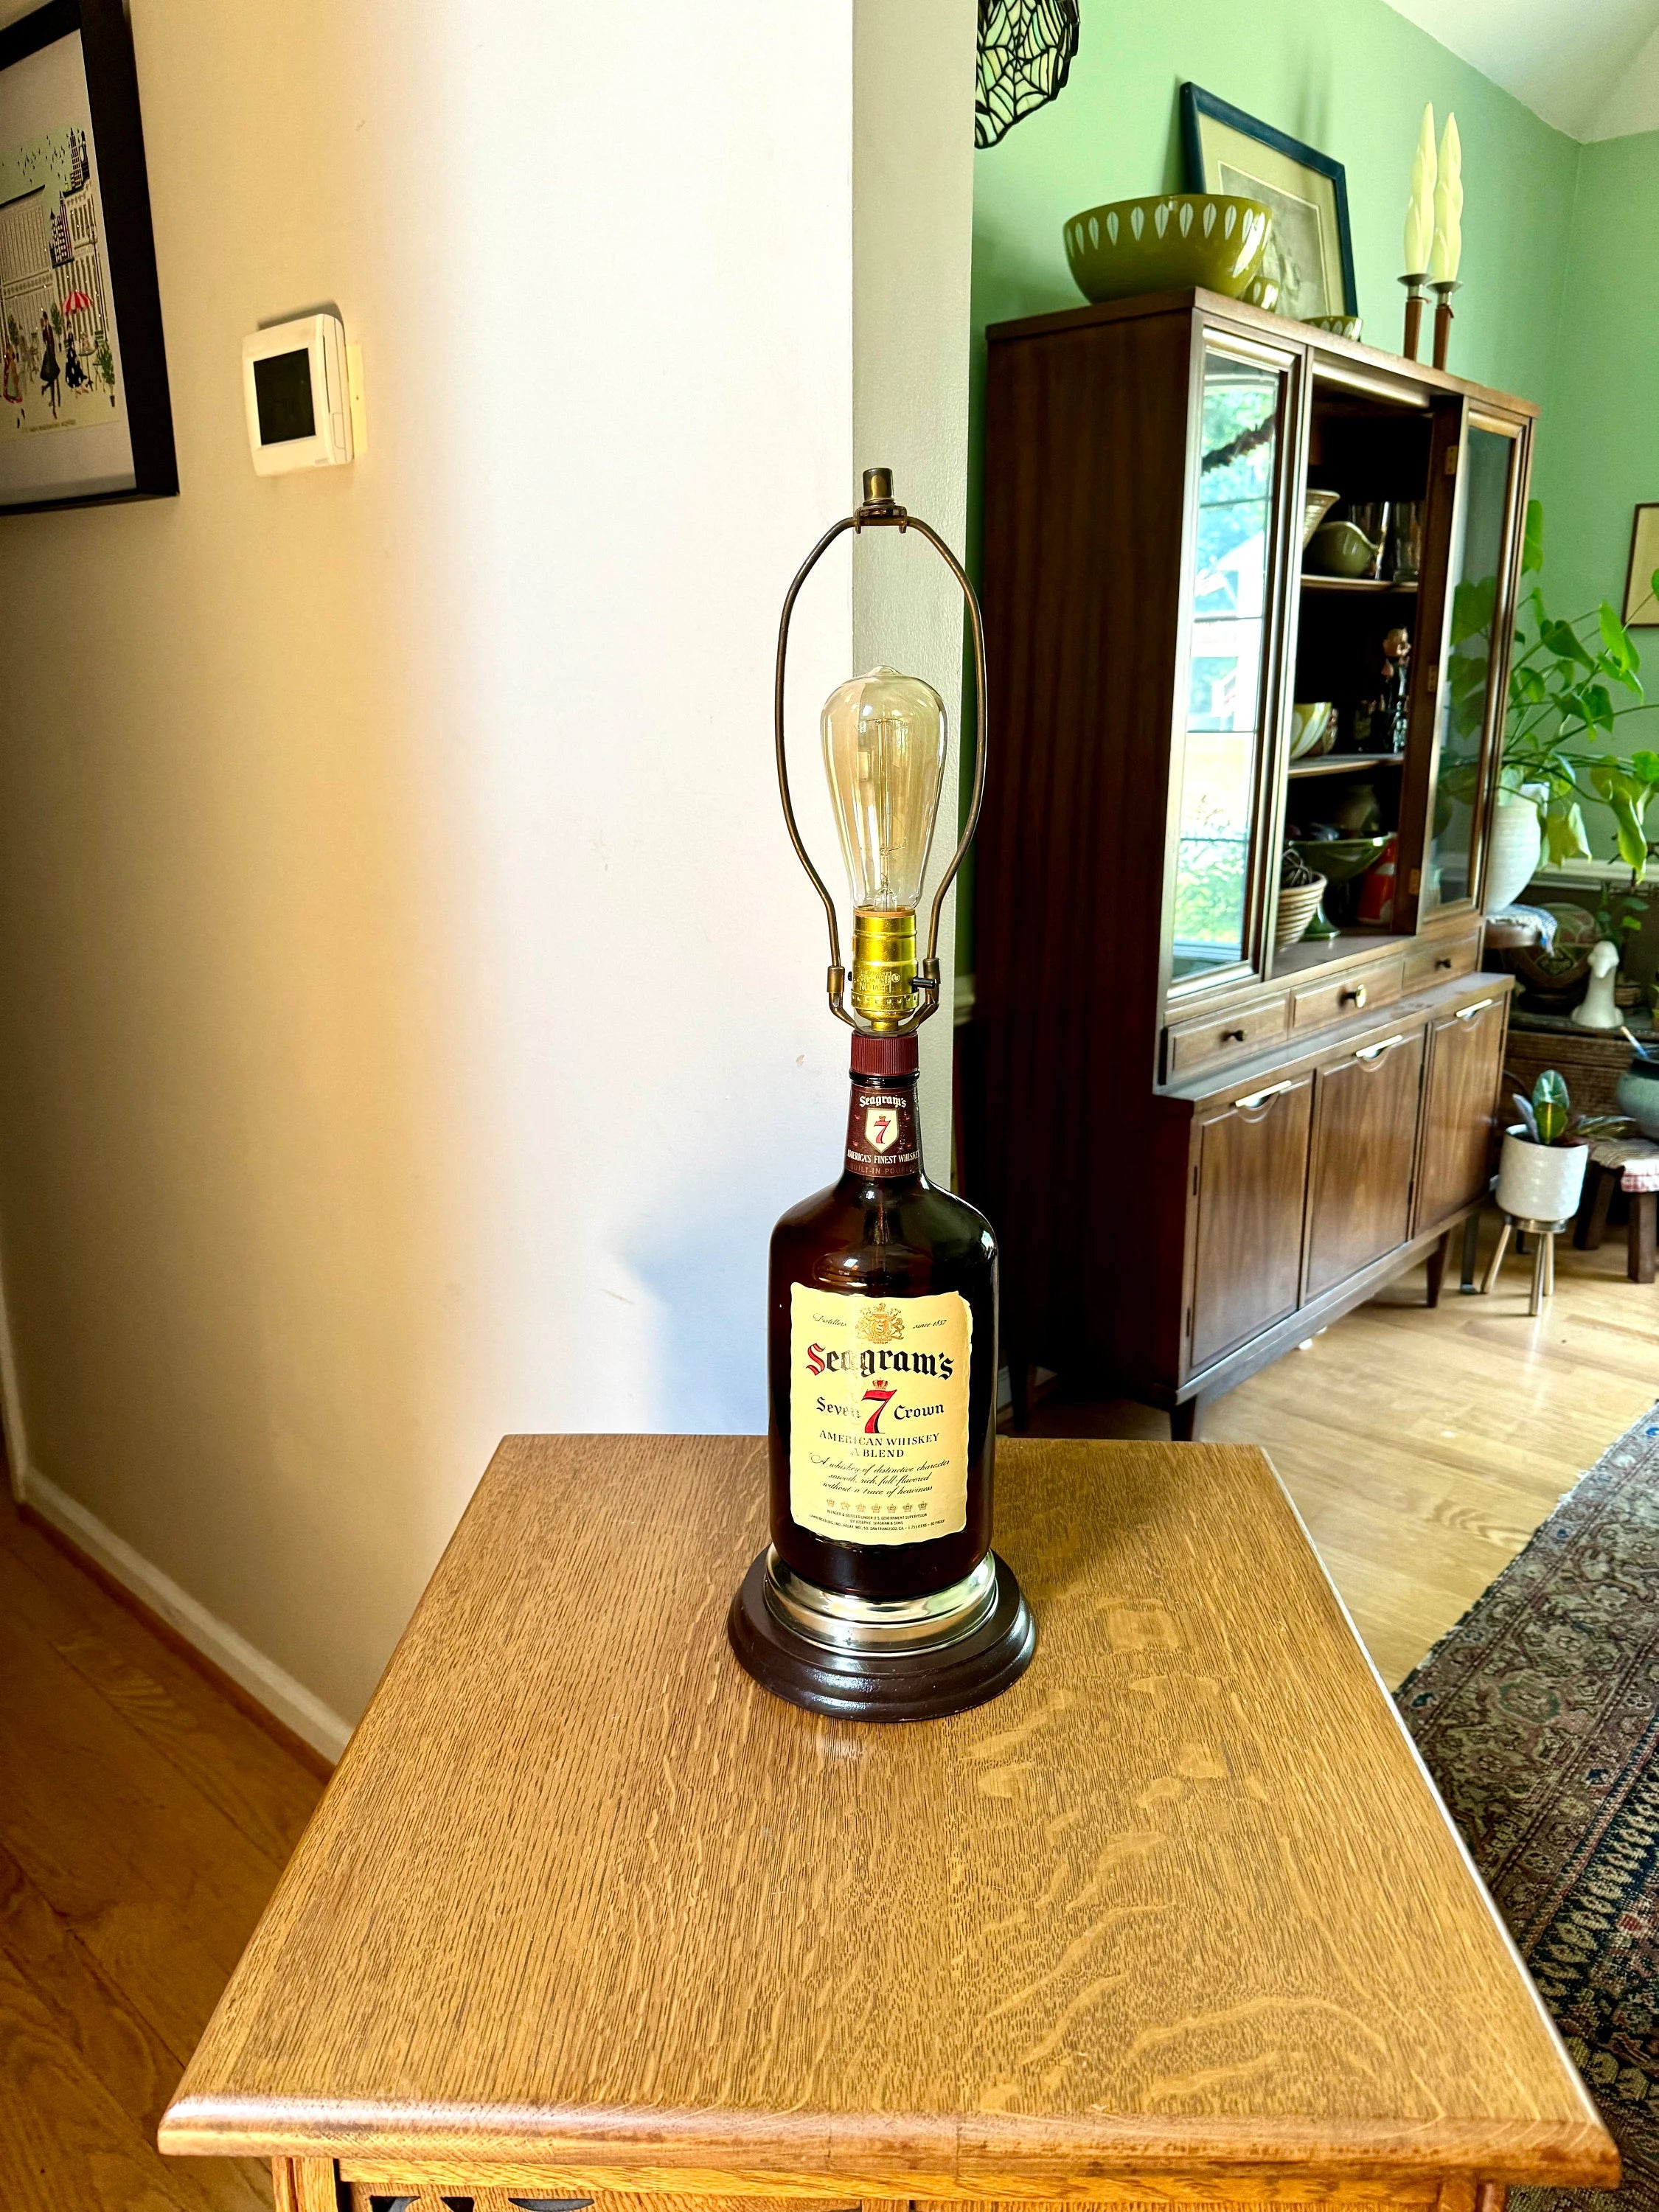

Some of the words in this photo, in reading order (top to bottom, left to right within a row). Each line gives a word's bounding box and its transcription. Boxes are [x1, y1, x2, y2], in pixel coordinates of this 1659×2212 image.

[859, 1094, 907, 1107] Seagram's
[874, 1119, 891, 1144] 7
[847, 1149, 872, 1164] AMERICA'S
[874, 1155, 897, 1164] FINEST
[850, 1164, 880, 1175] BUILT-IN
[806, 1343, 954, 1380] Seagram's
[861, 1389, 897, 1434] 7
[894, 1404, 945, 1420] Crown
[819, 1430, 883, 1446] AMERICAN
[886, 1433, 939, 1446] WHISKEY
[863, 1449, 904, 1458] BLEND
[829, 1461, 860, 1473] whiskey
[862, 1464, 876, 1475] of
[874, 1464, 914, 1473] distinctive
[917, 1459, 950, 1471] character
[877, 1472, 933, 1486] full-flavored
[823, 1481, 852, 1492] without
[886, 1486, 900, 1498] of
[897, 1486, 933, 1495] heaviness
